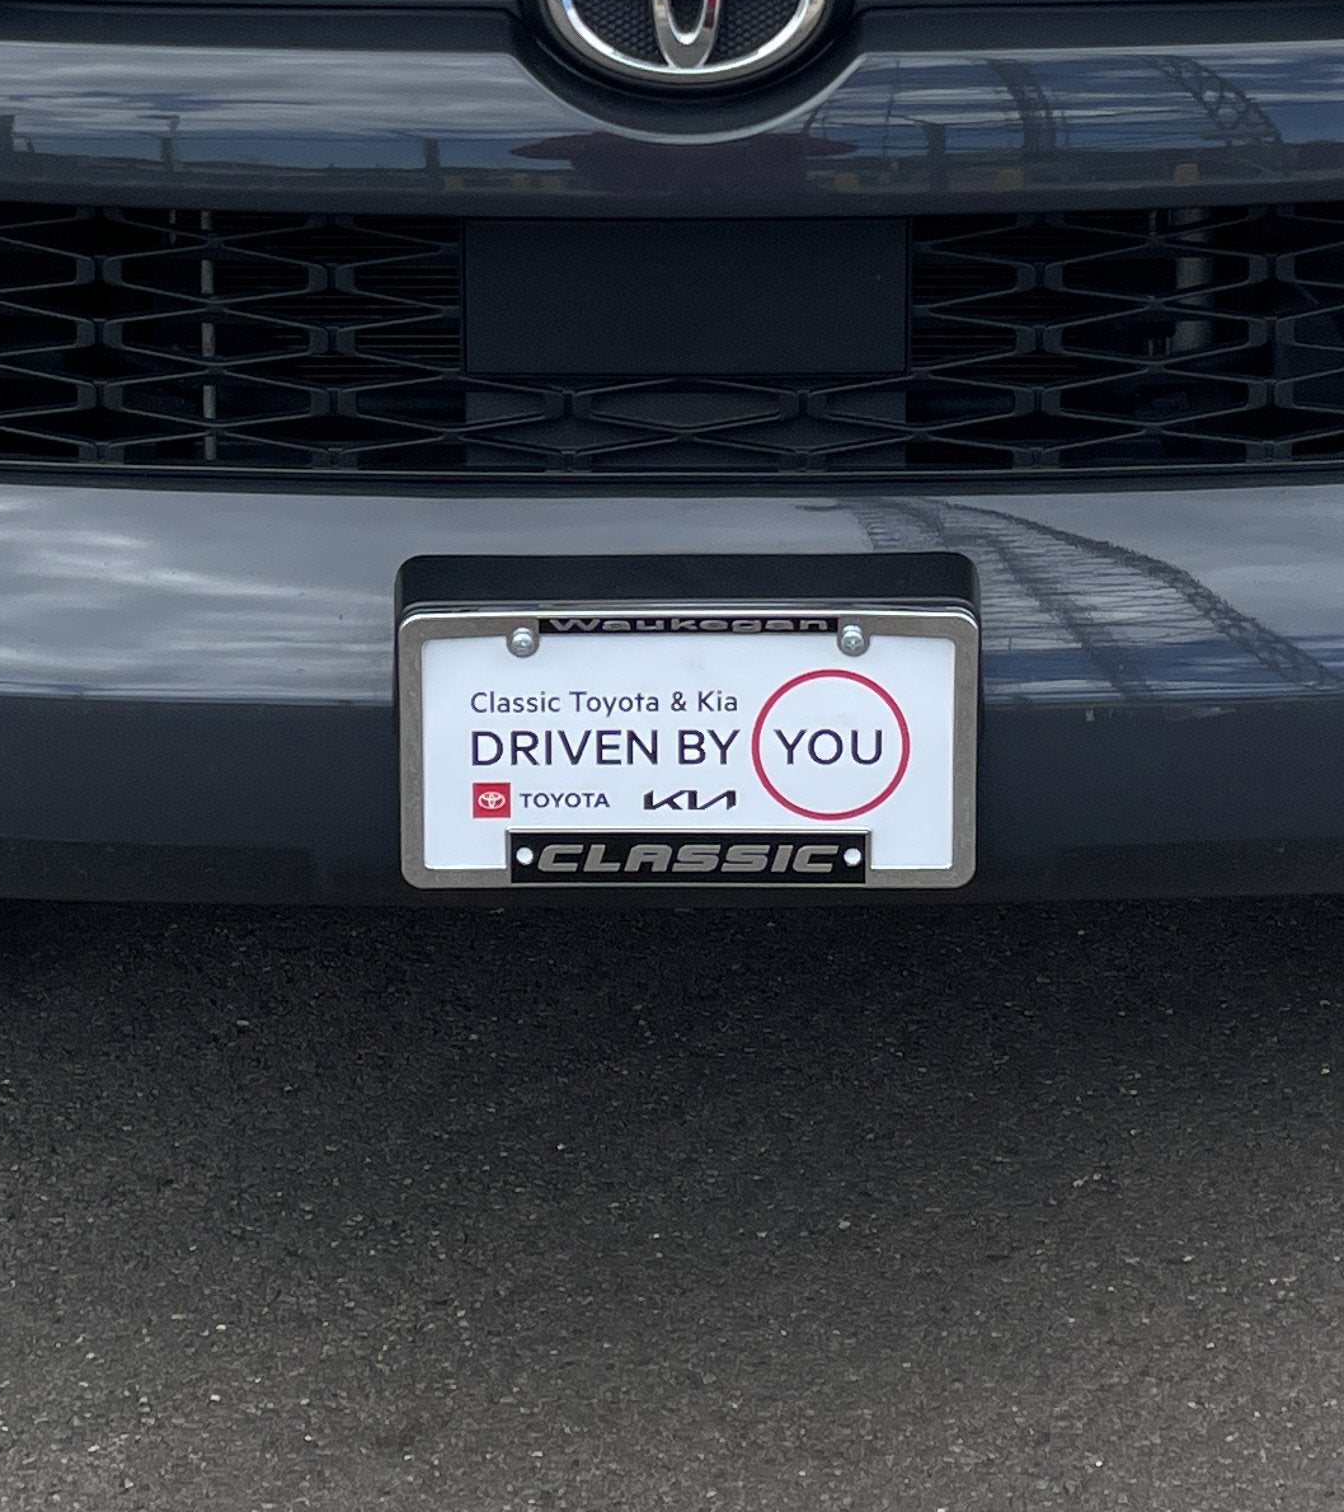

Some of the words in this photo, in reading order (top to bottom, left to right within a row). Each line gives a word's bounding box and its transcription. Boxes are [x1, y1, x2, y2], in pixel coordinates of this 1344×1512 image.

[470, 691, 561, 713] Classic
[570, 691, 660, 717] Toyota
[670, 691, 688, 712] &
[698, 690, 738, 712] Kia
[471, 729, 659, 766] DRIVEN
[678, 729, 740, 765] BY
[774, 729, 884, 765] YOU
[520, 793, 610, 809] TOYOTA
[537, 845, 840, 873] CLASSIC
